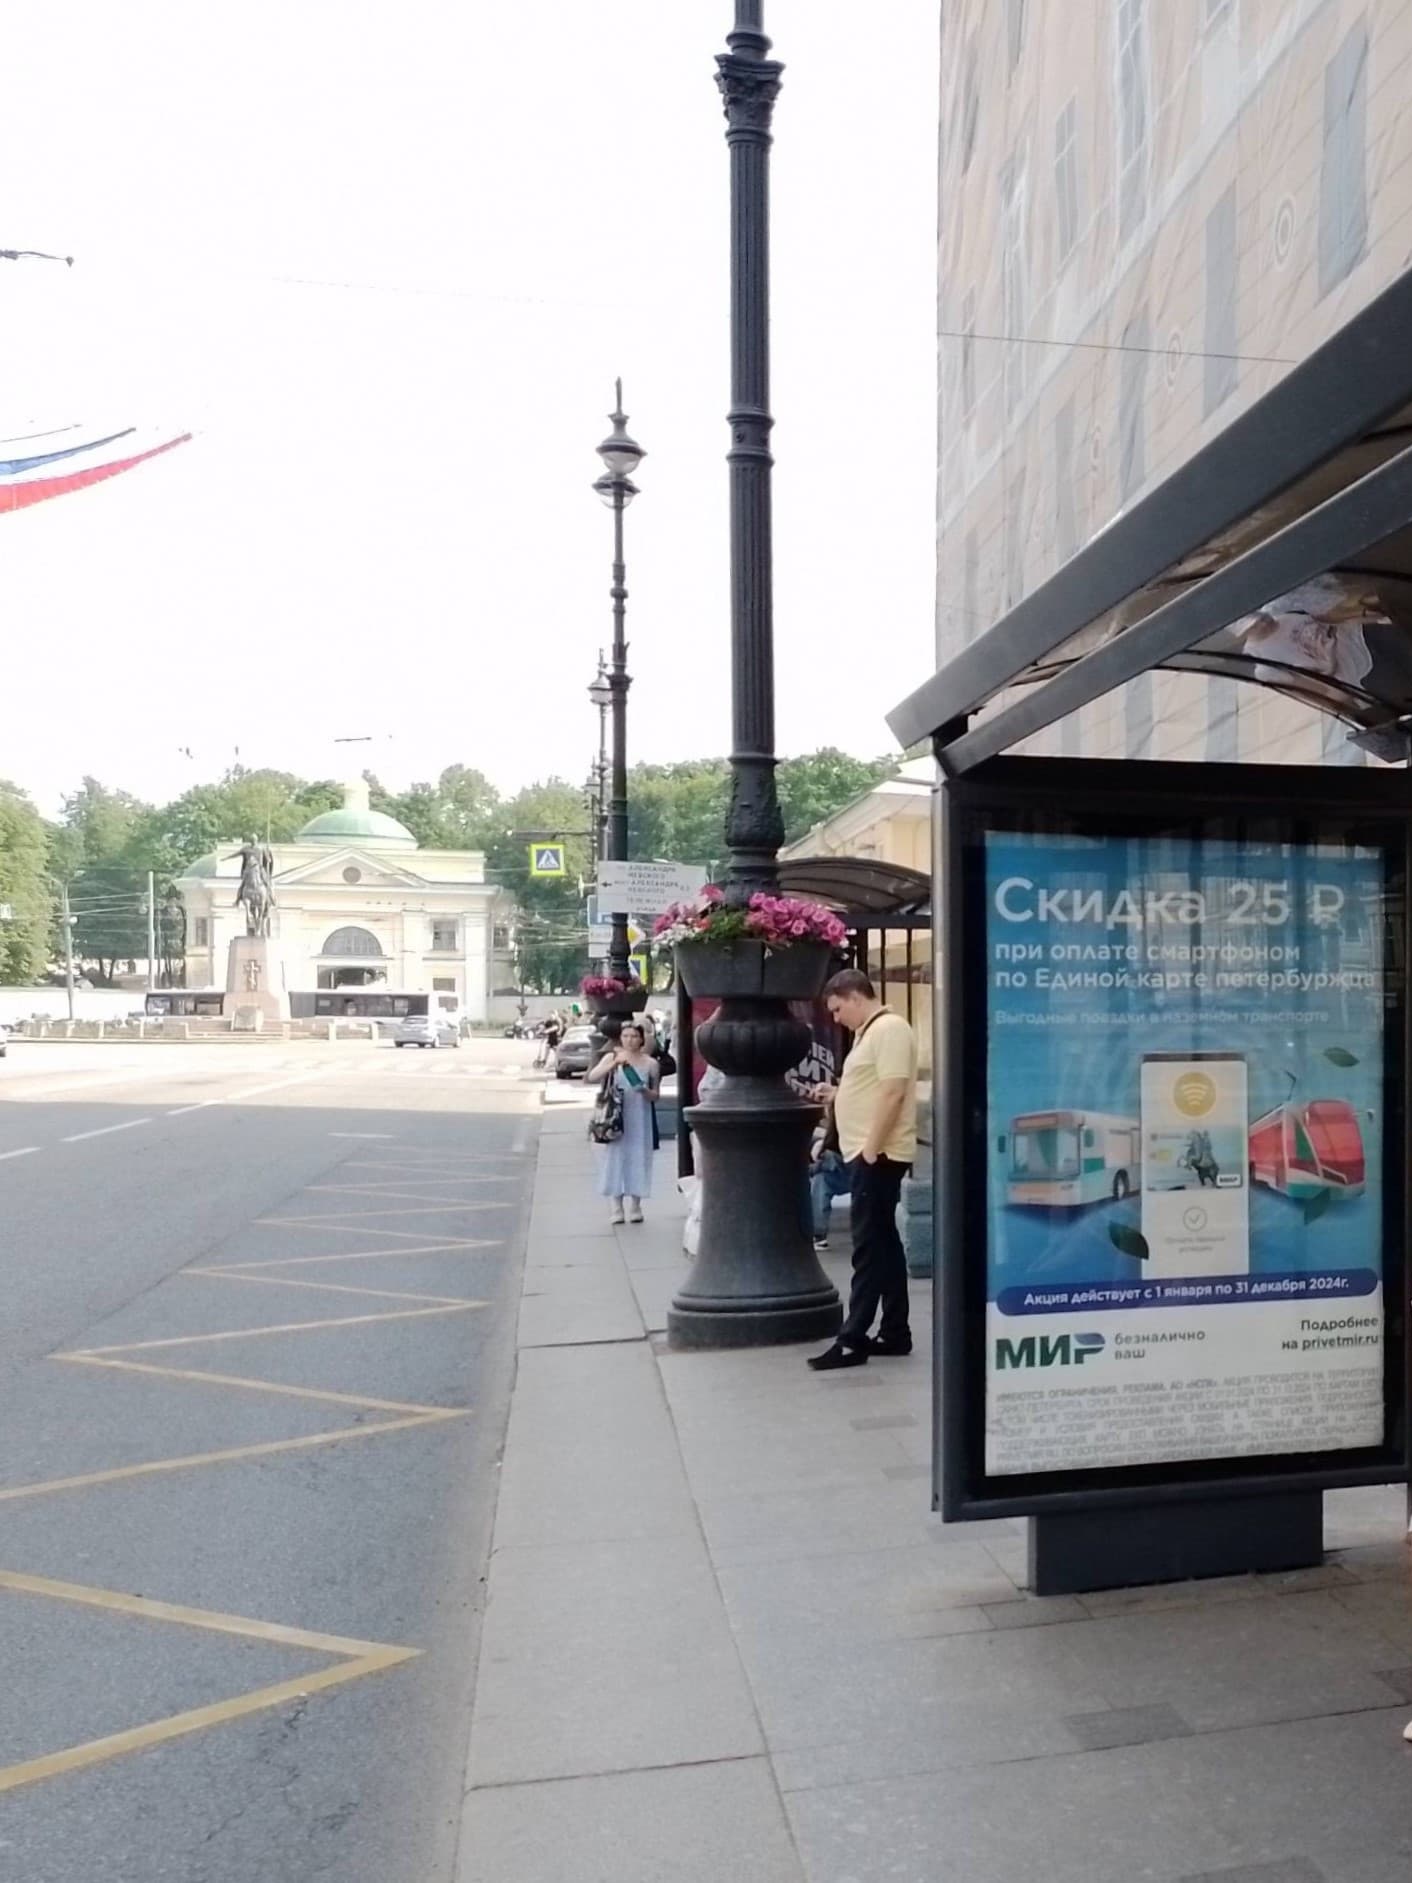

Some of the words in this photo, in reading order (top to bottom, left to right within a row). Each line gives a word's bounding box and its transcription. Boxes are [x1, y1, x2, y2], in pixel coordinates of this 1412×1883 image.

[995, 877, 1207, 931] Скидка
[1227, 883, 1290, 926] 25
[995, 943, 1044, 963] при
[1050, 944, 1139, 962] оплате
[1147, 940, 1300, 966] смартфоном
[995, 972, 1026, 988] по
[1035, 966, 1129, 991] Единой
[1138, 971, 1207, 993] карте
[1215, 967, 1376, 993] петербуржца
[1024, 1291, 1069, 1307] Акция
[1071, 1287, 1141, 1306] действует
[1144, 1289, 1152, 1300] с
[1163, 1284, 1213, 1300] января
[1215, 1284, 1233, 1296] по
[1235, 1280, 1249, 1295] 31
[1251, 1277, 1306, 1295] декабря
[1114, 1328, 1206, 1346] безналично
[1300, 1316, 1379, 1332] Подробнее
[995, 1332, 1107, 1370] МИР
[1114, 1348, 1146, 1360] ваш
[1282, 1339, 1299, 1350] на
[1302, 1333, 1379, 1353] privetmir.ru
